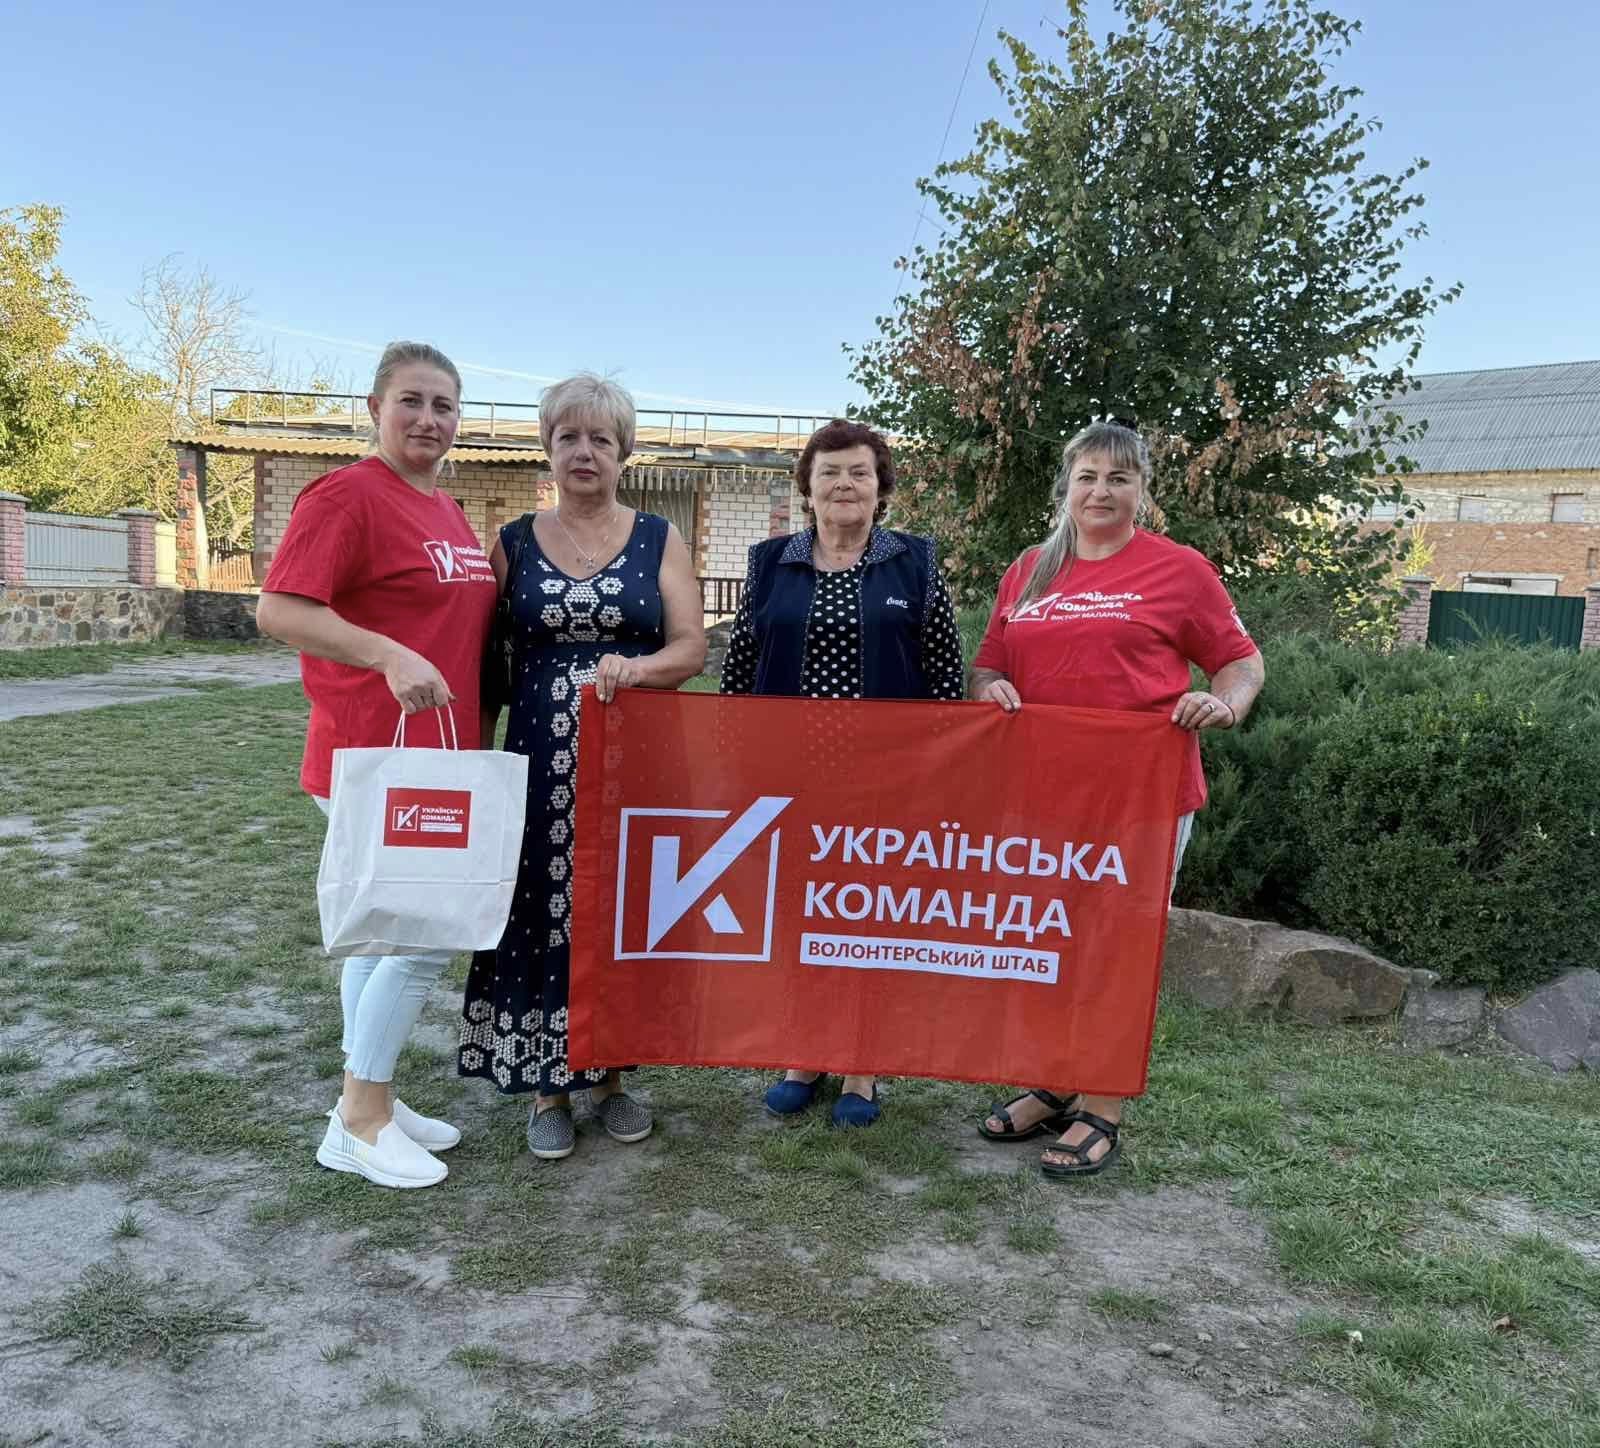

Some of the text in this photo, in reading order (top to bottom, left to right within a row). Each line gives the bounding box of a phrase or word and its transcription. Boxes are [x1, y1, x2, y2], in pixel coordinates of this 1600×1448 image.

[421, 806, 464, 815] УКРАЇНСЬКА
[809, 821, 1129, 885] УКРАЇНСЬКА
[803, 880, 1072, 943] КОМАНДА
[808, 939, 1049, 974] ВОЛОНТЕРСЬКИЙ ШТАБ
